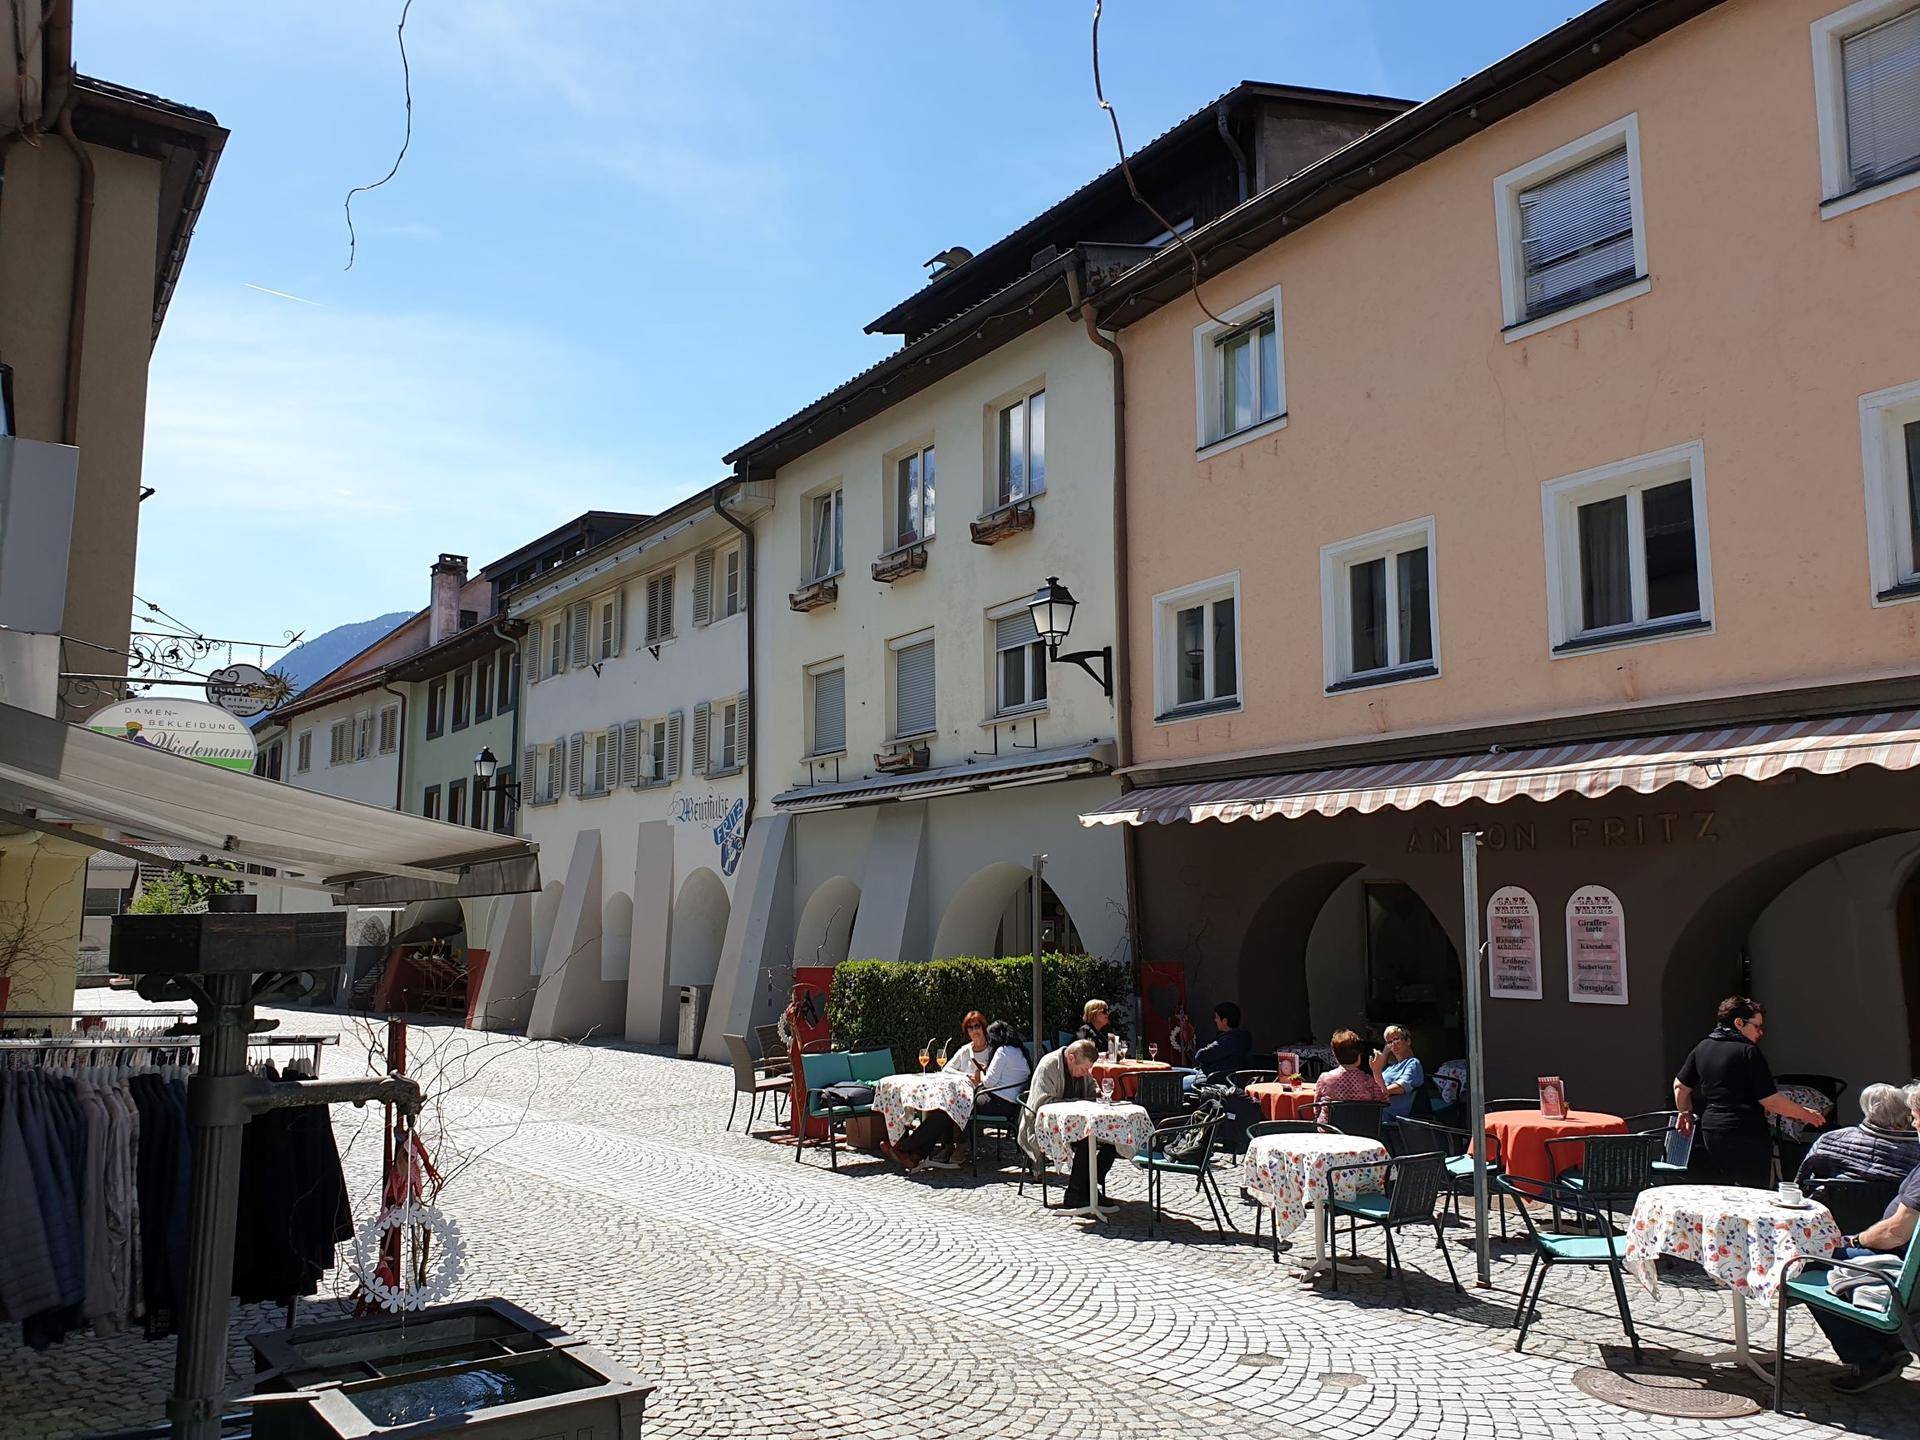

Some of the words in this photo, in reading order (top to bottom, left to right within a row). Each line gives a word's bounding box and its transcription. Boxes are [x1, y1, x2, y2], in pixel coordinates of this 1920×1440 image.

[124, 707, 179, 716] DAMEN-
[148, 719, 236, 731] BEKLEIDUNG
[150, 731, 253, 758] Wiedemann
[1568, 809, 1719, 850] FRITZ
[1494, 905, 1530, 915] FRITZ
[1574, 905, 1614, 915] FRITZ
